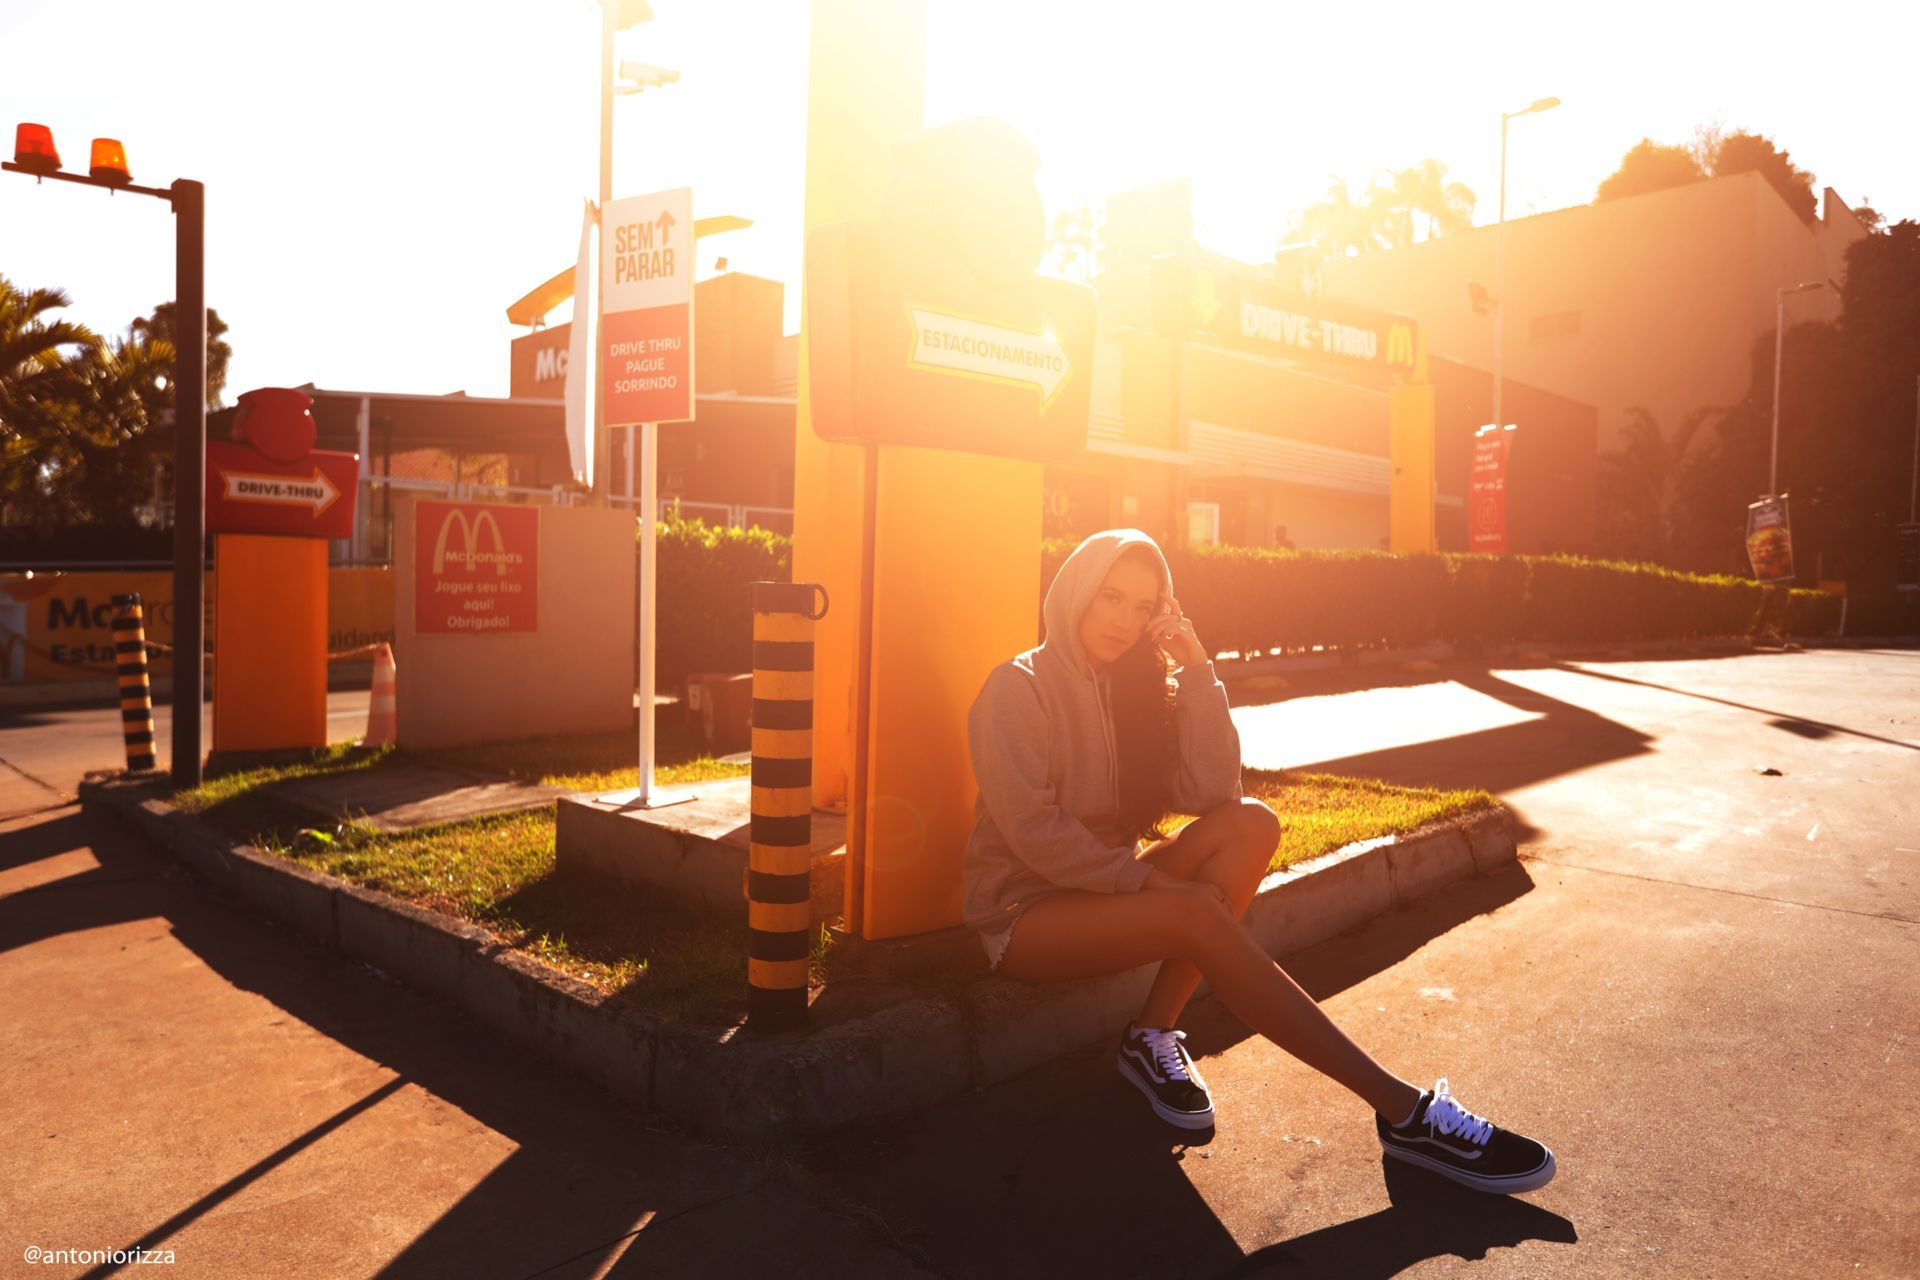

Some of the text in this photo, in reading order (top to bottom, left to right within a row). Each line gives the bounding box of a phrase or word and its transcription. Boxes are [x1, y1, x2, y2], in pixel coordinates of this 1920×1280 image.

[615, 221, 653, 254] SEM
[615, 248, 674, 284] PARAR
[1241, 301, 1376, 360] DRIVE-THRU
[610, 336, 681, 357] DRIVE THRU
[922, 329, 1064, 373] ESTACIONAMENTO
[626, 357, 665, 373] PAGUE
[615, 375, 677, 394] SORRINDO
[237, 481, 324, 499] DRIVE-THRU
[435, 580, 522, 595] Jogue seu lixo
[463, 598, 495, 613] aqui!
[447, 616, 510, 630] Obrigado!
